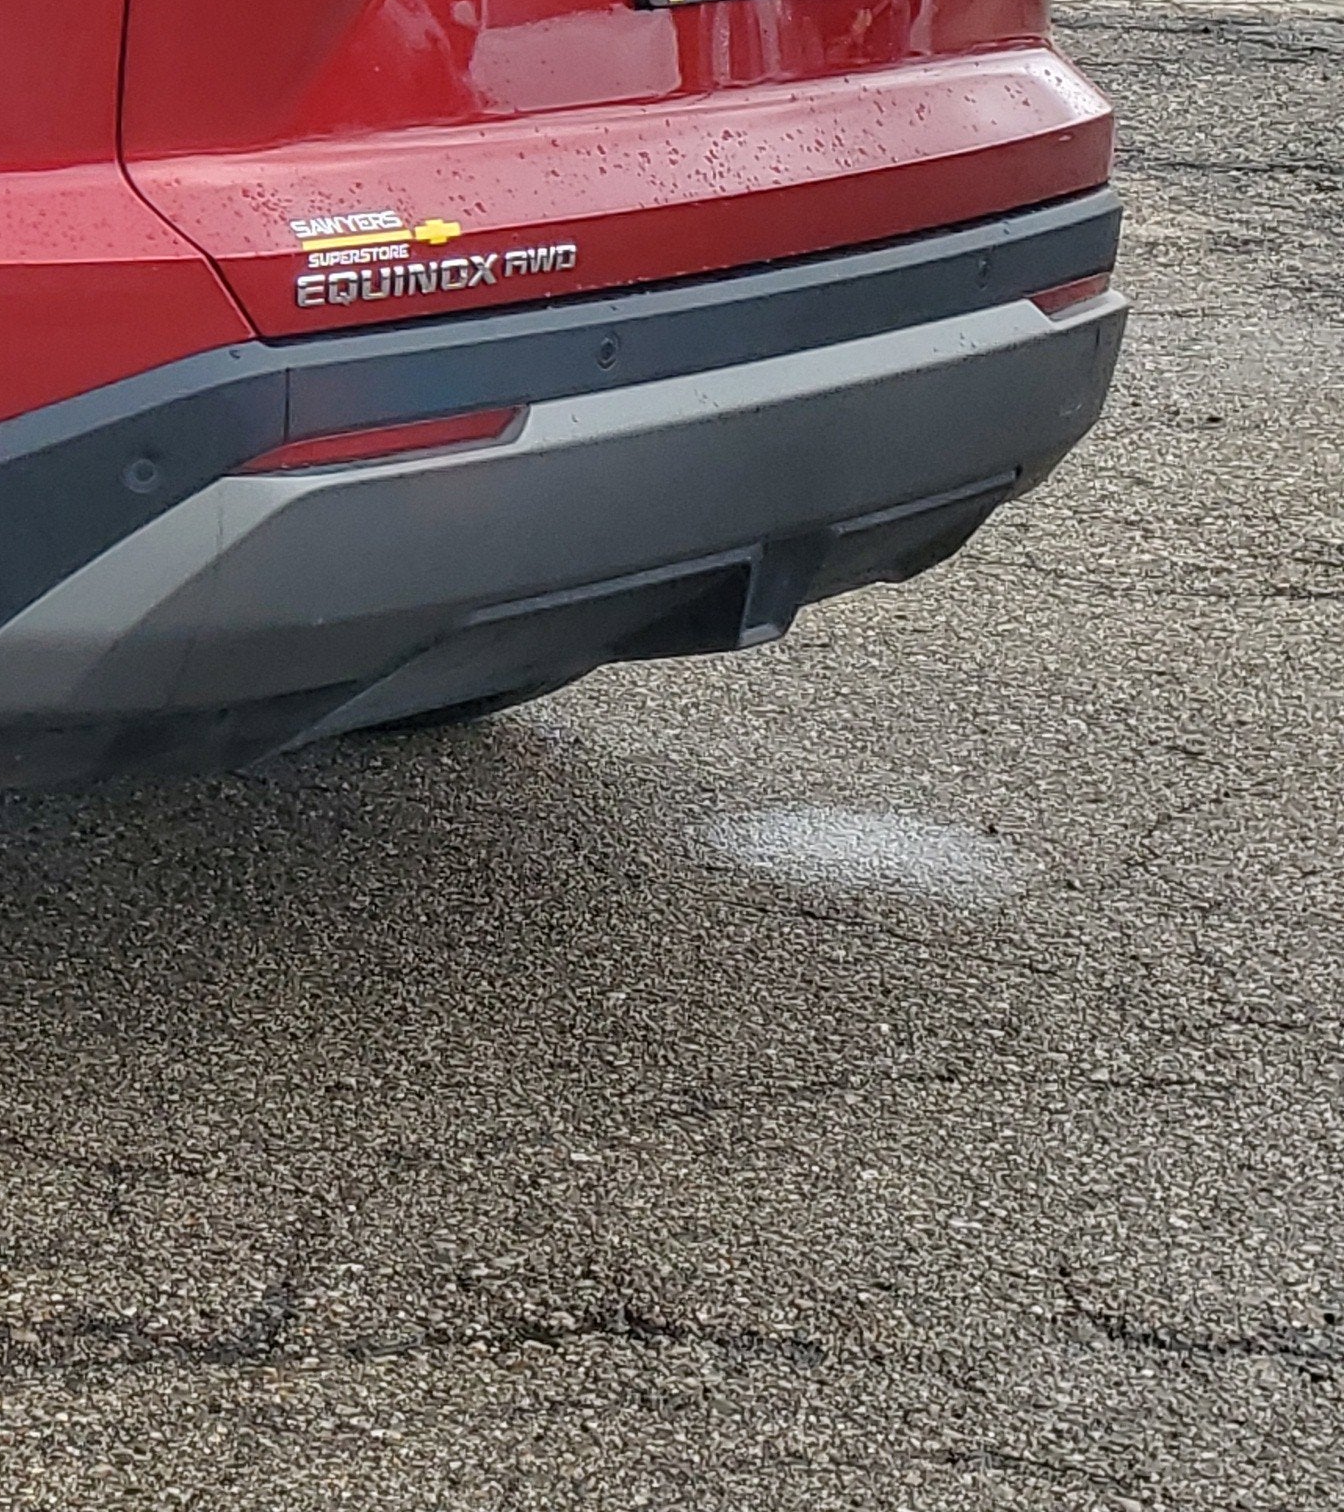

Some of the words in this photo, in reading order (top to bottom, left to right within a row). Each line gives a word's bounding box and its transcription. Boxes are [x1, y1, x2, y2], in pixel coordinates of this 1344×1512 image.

[290, 210, 404, 238] SAWYERS
[308, 243, 411, 268] SUPERSTORE
[297, 252, 498, 307] EQUINOX
[504, 244, 577, 277] AWD
